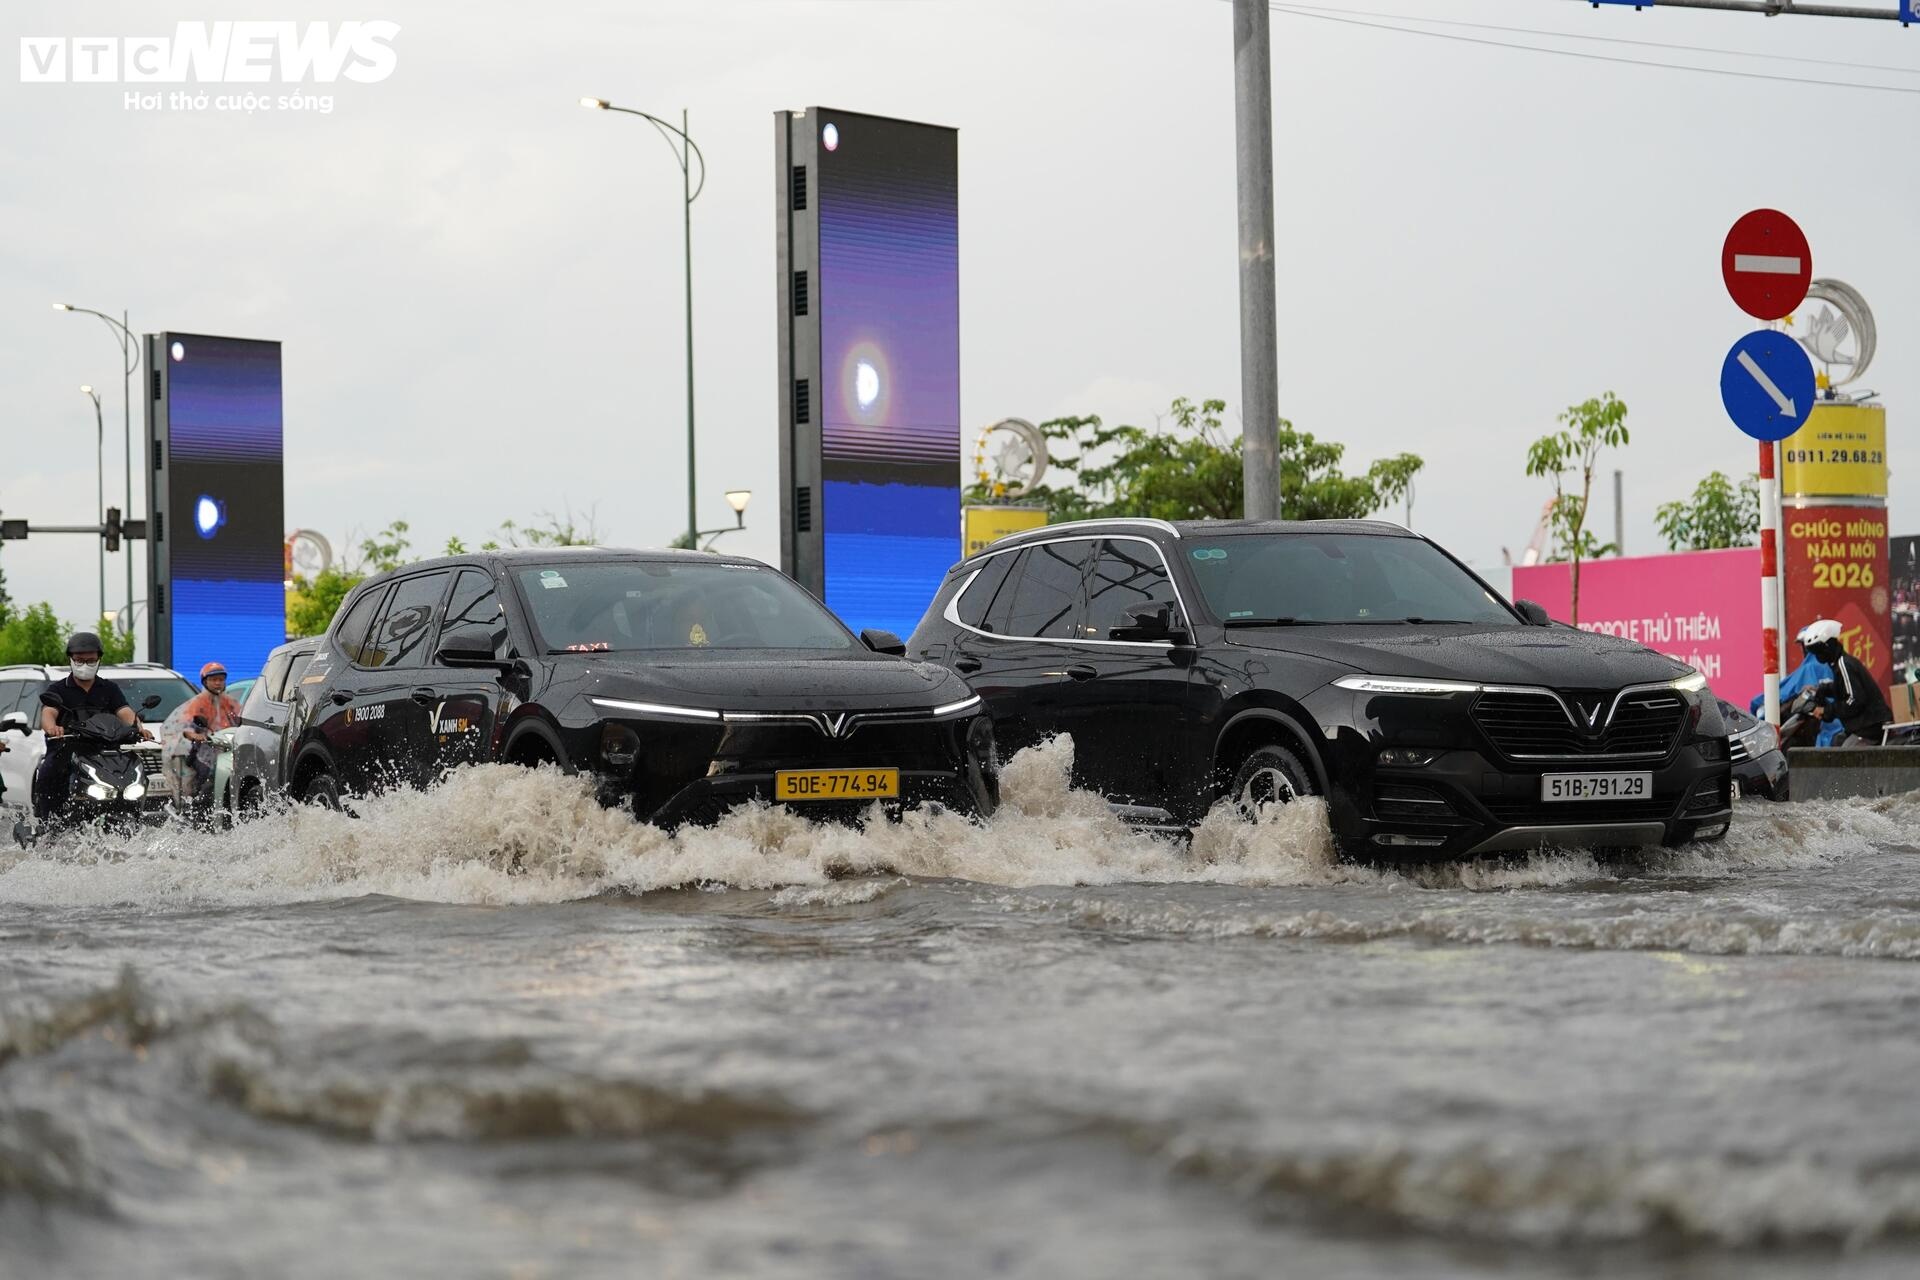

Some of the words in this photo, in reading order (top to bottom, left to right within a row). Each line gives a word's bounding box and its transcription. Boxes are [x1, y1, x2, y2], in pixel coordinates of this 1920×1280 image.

[1787, 449, 1882, 464] 0911.29.68.28
[1790, 518, 1842, 538] CHÚC
[1846, 518, 1885, 538] MỪNG
[1806, 540, 1846, 559] NĂM
[1850, 539, 1876, 559] MỚI
[1813, 563, 1874, 588] 2026
[1642, 612, 1671, 643] THỦ
[1675, 611, 1721, 641] THIÊM
[355, 706, 370, 721] 1900
[439, 719, 458, 733] XANH
